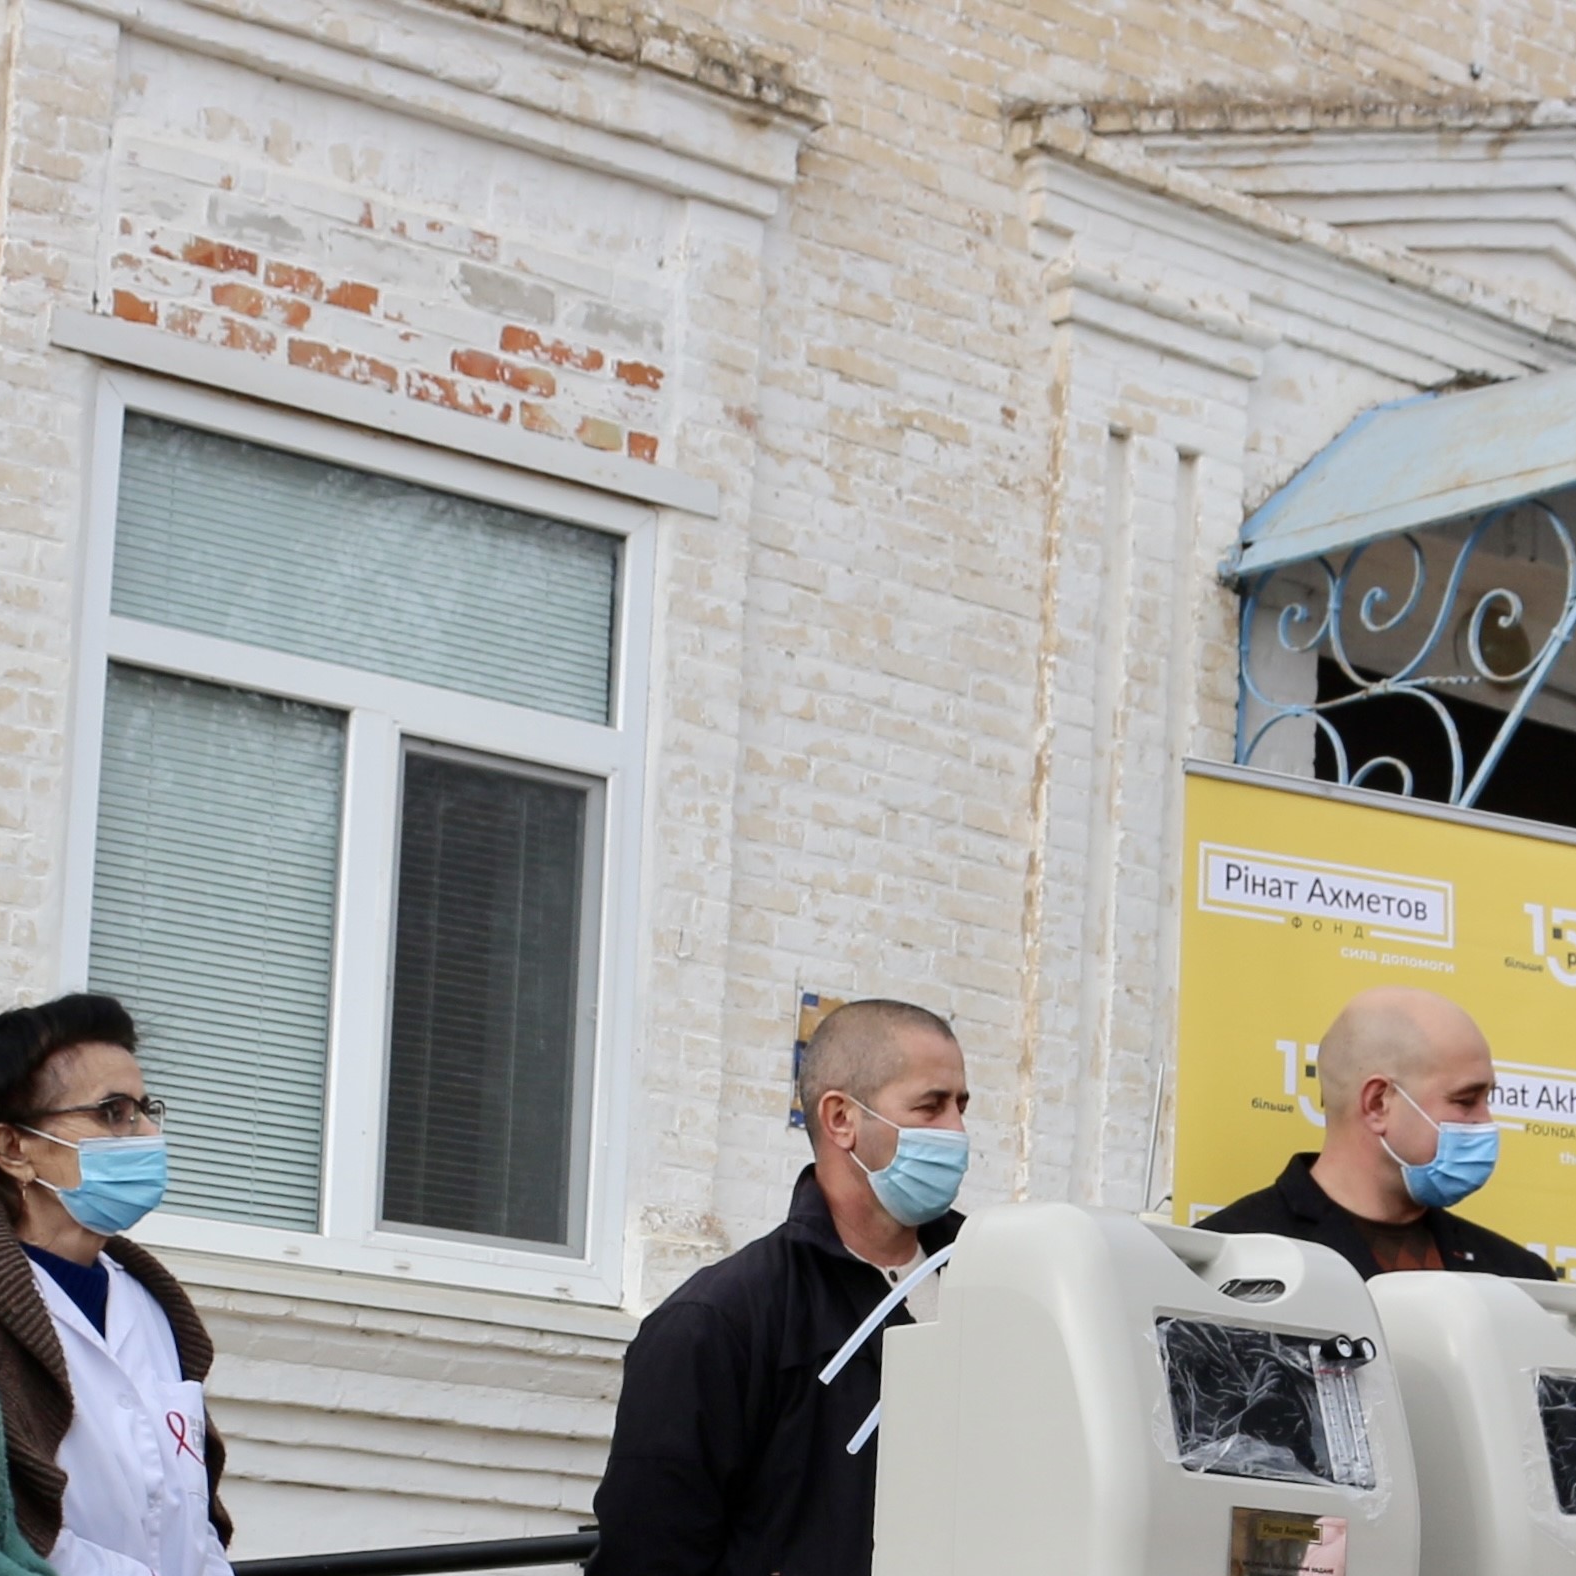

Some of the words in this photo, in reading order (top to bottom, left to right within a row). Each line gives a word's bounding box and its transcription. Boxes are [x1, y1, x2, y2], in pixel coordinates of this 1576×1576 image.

[1224, 862, 1299, 902] Рінат
[1307, 877, 1428, 922] Ахметов
[1340, 945, 1378, 964] сила
[1380, 952, 1456, 974] допомоги
[1490, 1083, 1530, 1108] nat
